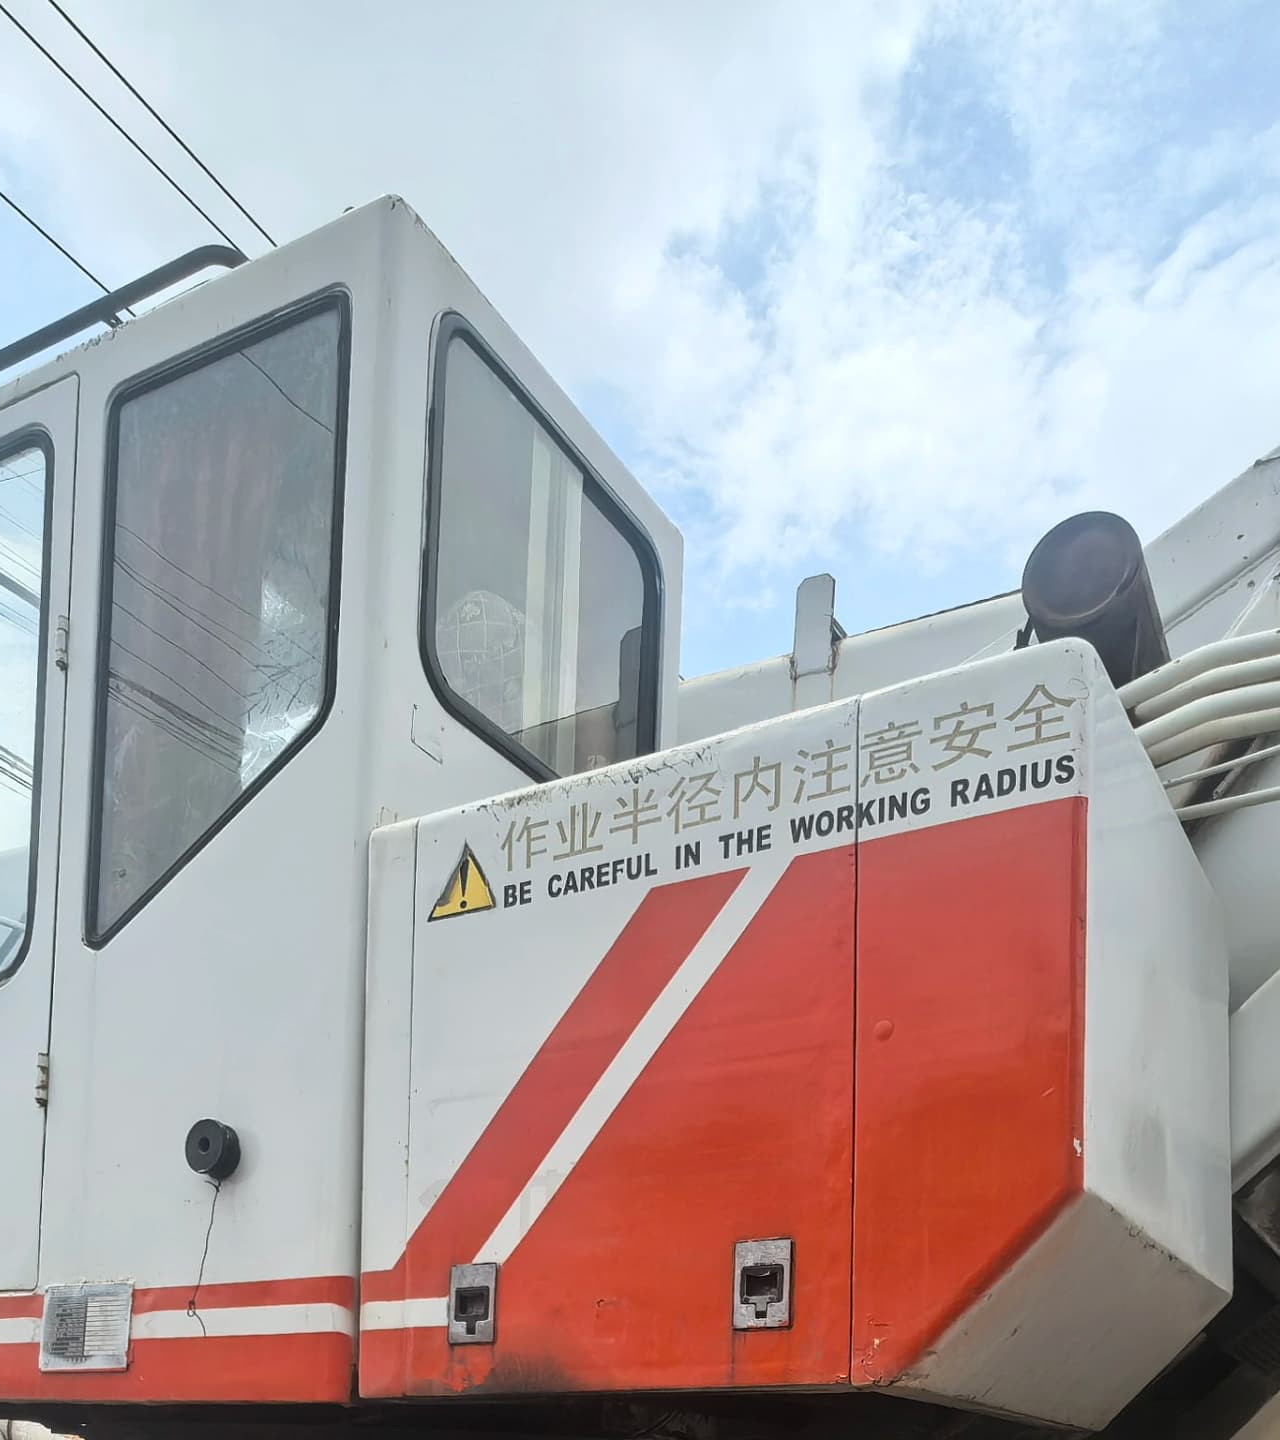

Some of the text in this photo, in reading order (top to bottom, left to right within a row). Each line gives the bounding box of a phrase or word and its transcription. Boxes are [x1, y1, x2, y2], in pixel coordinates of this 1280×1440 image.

[501, 684, 1077, 872] 作业半径内注意安全
[504, 755, 1075, 908] BE CAREFUL IN THE WORKING RADIUS
